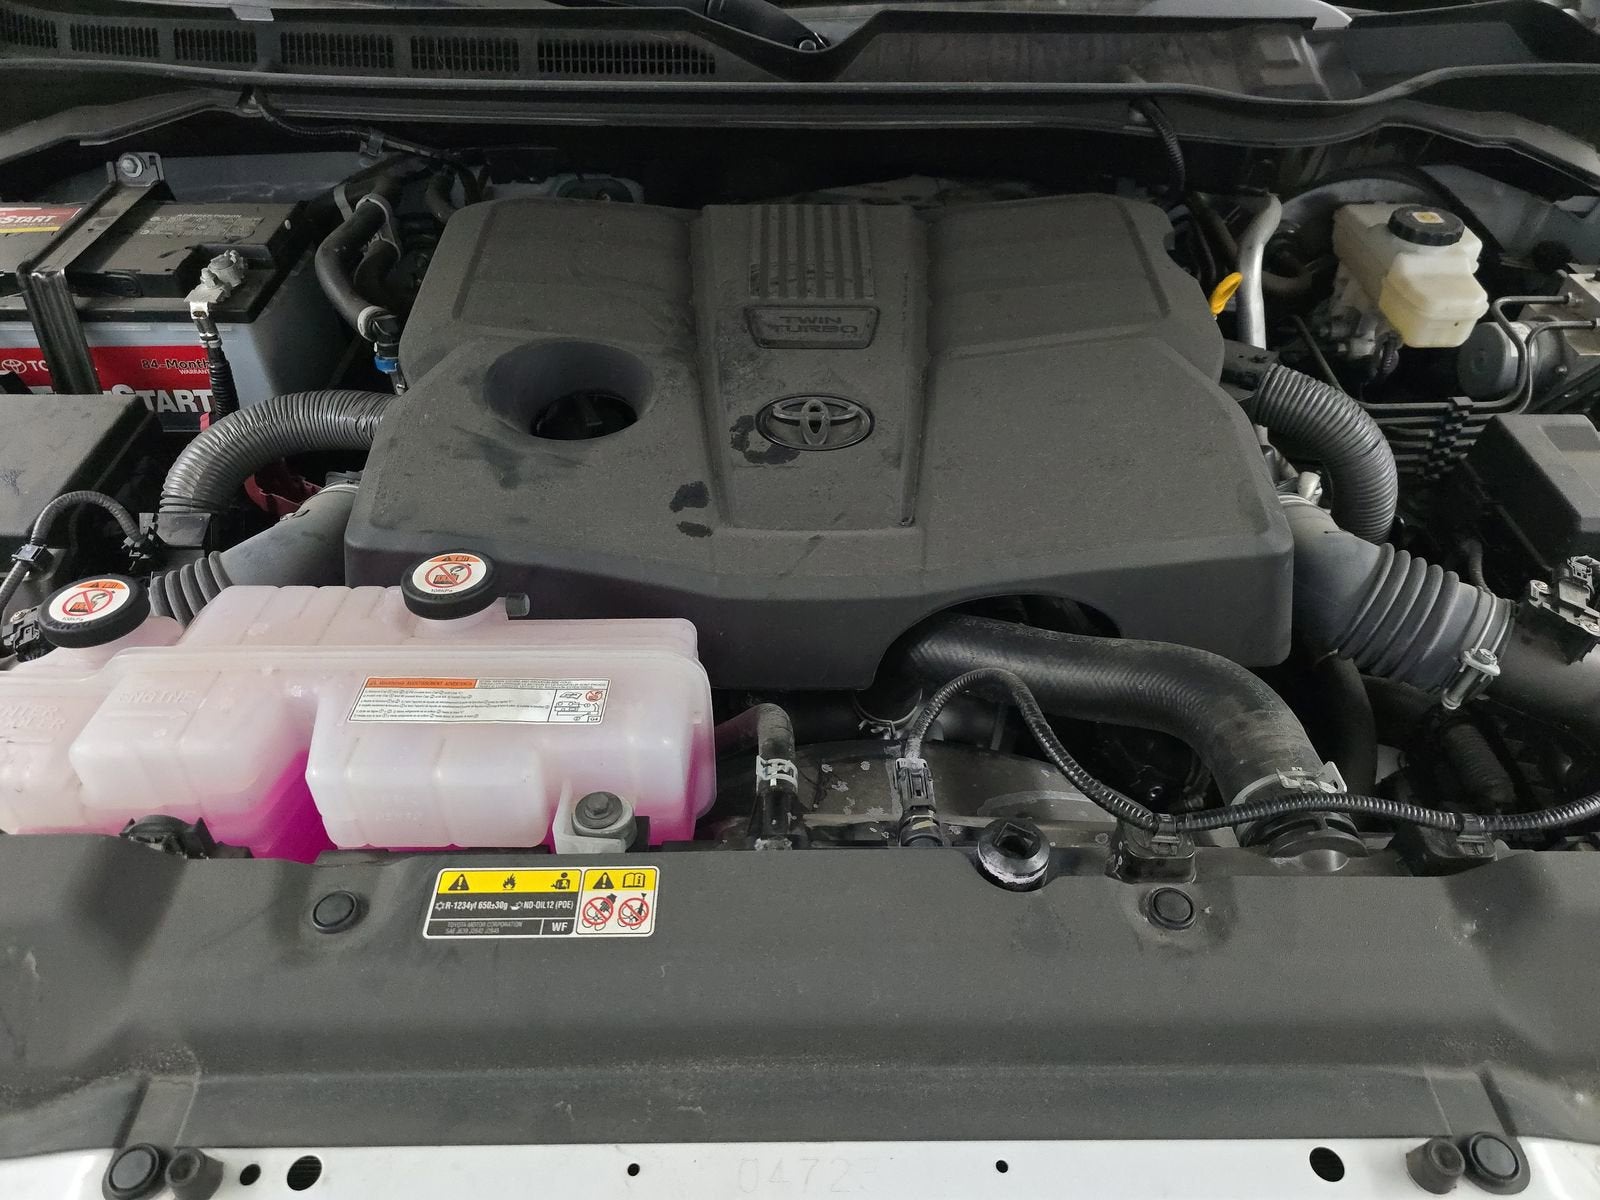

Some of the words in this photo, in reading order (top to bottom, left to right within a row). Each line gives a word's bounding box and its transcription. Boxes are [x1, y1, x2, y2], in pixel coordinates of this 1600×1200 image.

[0, 215, 58, 224] START
[779, 316, 842, 325] TWIN
[768, 325, 858, 334] TURBO
[444, 901, 477, 911] R-1234yf
[478, 901, 509, 911] 650±30g
[523, 901, 554, 909] ND-OIL12
[555, 900, 574, 910] (POE)
[551, 921, 569, 932] WF
